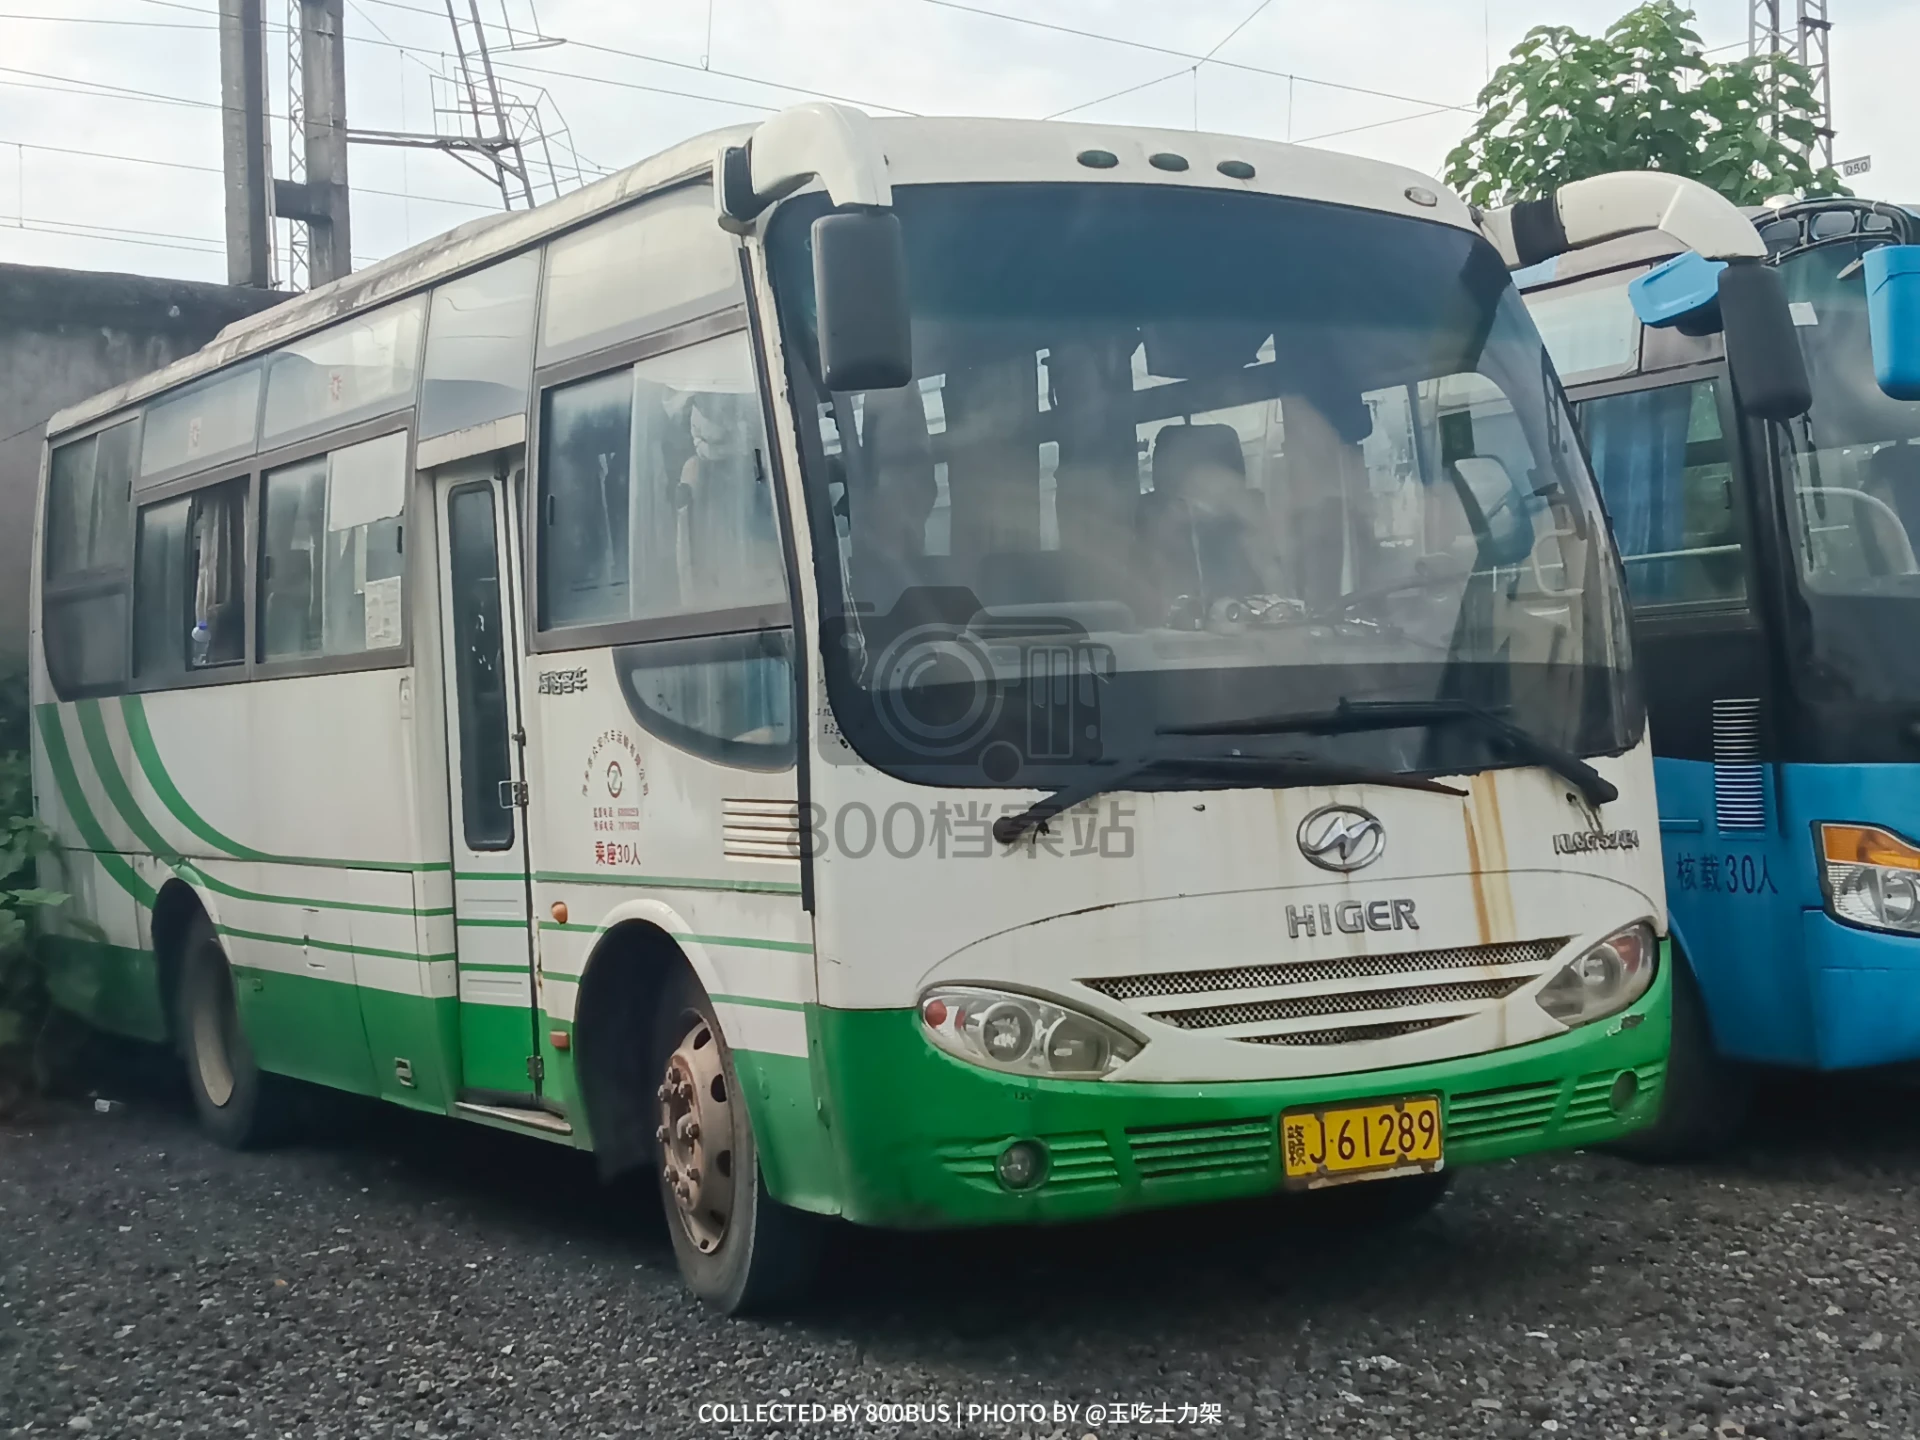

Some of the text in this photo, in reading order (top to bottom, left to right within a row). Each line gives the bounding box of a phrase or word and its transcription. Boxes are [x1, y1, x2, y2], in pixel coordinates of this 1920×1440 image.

[595, 840, 641, 866] 乘座30人
[1676, 852, 1778, 894] 核载30人
[1285, 898, 1420, 938] HIGER
